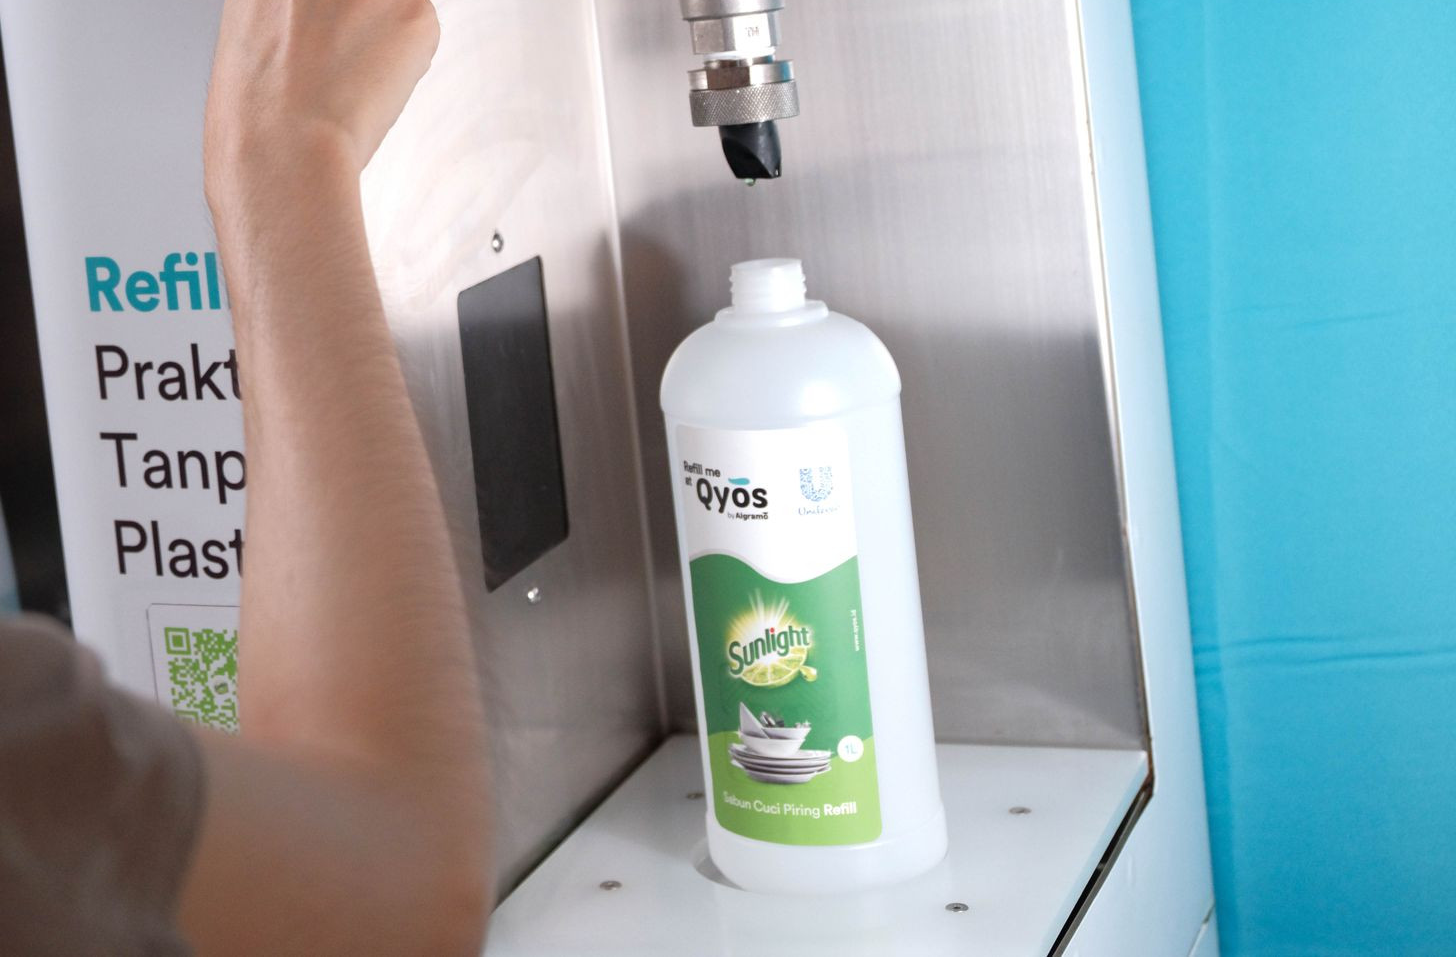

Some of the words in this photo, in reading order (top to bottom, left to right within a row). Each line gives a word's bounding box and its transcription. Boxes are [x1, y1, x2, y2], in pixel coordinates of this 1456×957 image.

[85, 251, 232, 312] Refil
[99, 432, 247, 505] Tanp
[683, 460, 703, 475] Refill
[705, 467, 721, 478] me
[685, 476, 693, 486] at
[696, 477, 769, 514] Qyos
[727, 512, 735, 520] by
[728, 625, 811, 675] Sunlight
[845, 744, 857, 755] 1L
[723, 790, 752, 810] Sabun
[753, 799, 781, 815] Cuci
[783, 802, 821, 819] Piring
[824, 800, 857, 816] Refill
